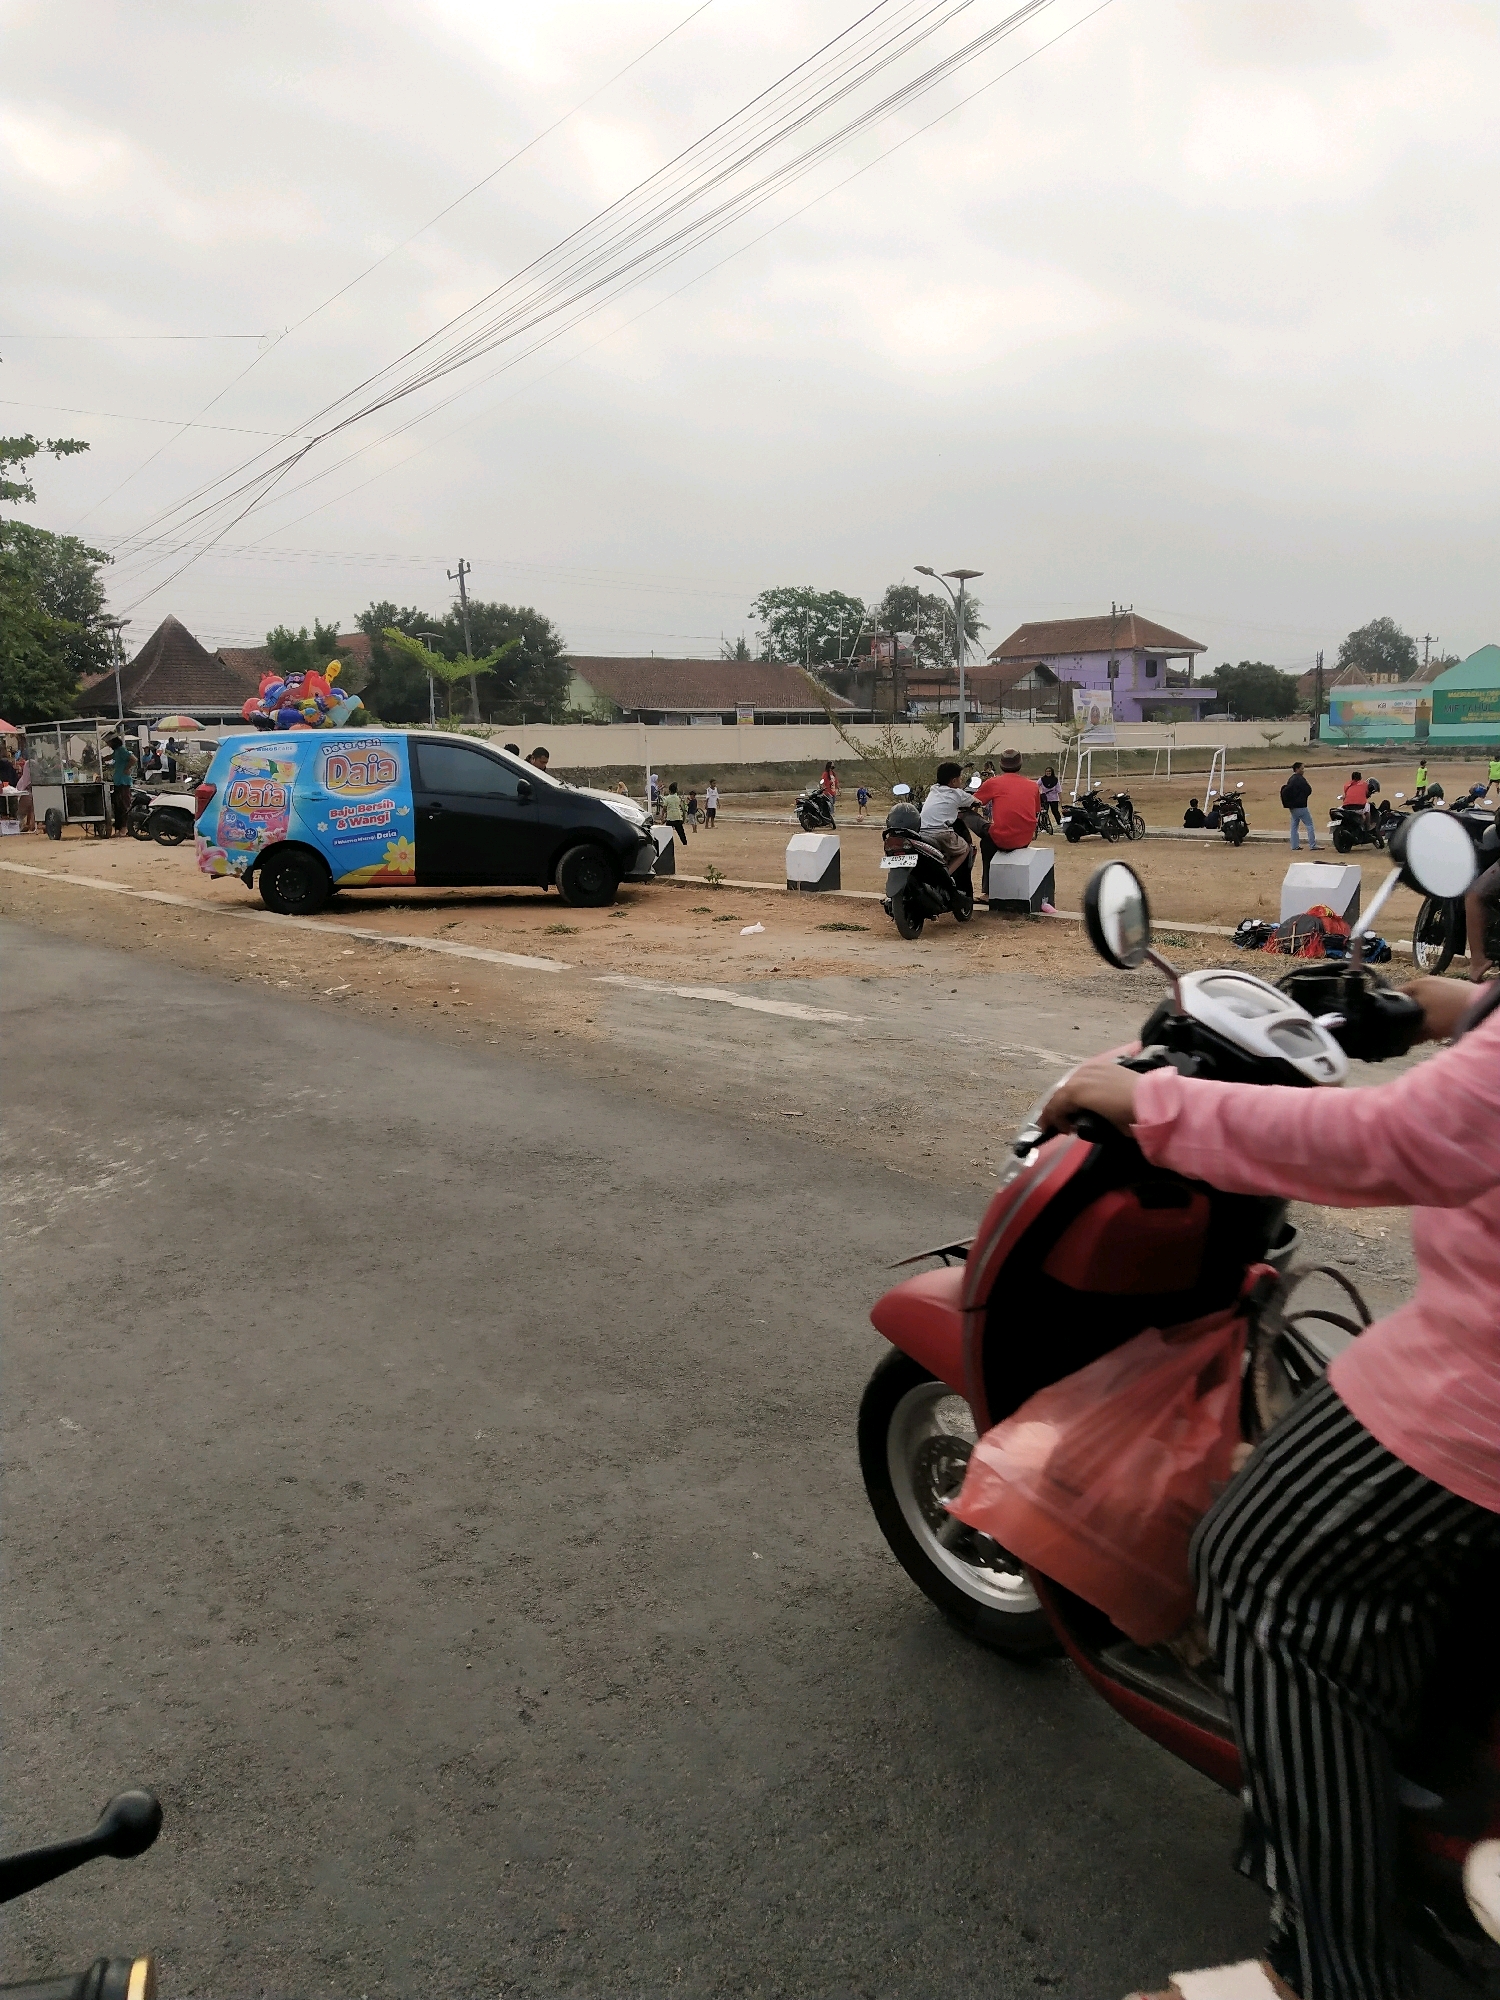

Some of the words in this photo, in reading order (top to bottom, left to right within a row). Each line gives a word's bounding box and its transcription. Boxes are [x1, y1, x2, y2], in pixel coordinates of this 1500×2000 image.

[326, 753, 397, 791] Daia
[229, 781, 285, 807] Daia
[329, 806, 356, 818] Baju
[357, 799, 395, 814] Bersih
[337, 819, 347, 829] &
[348, 811, 390, 827] Wangi
